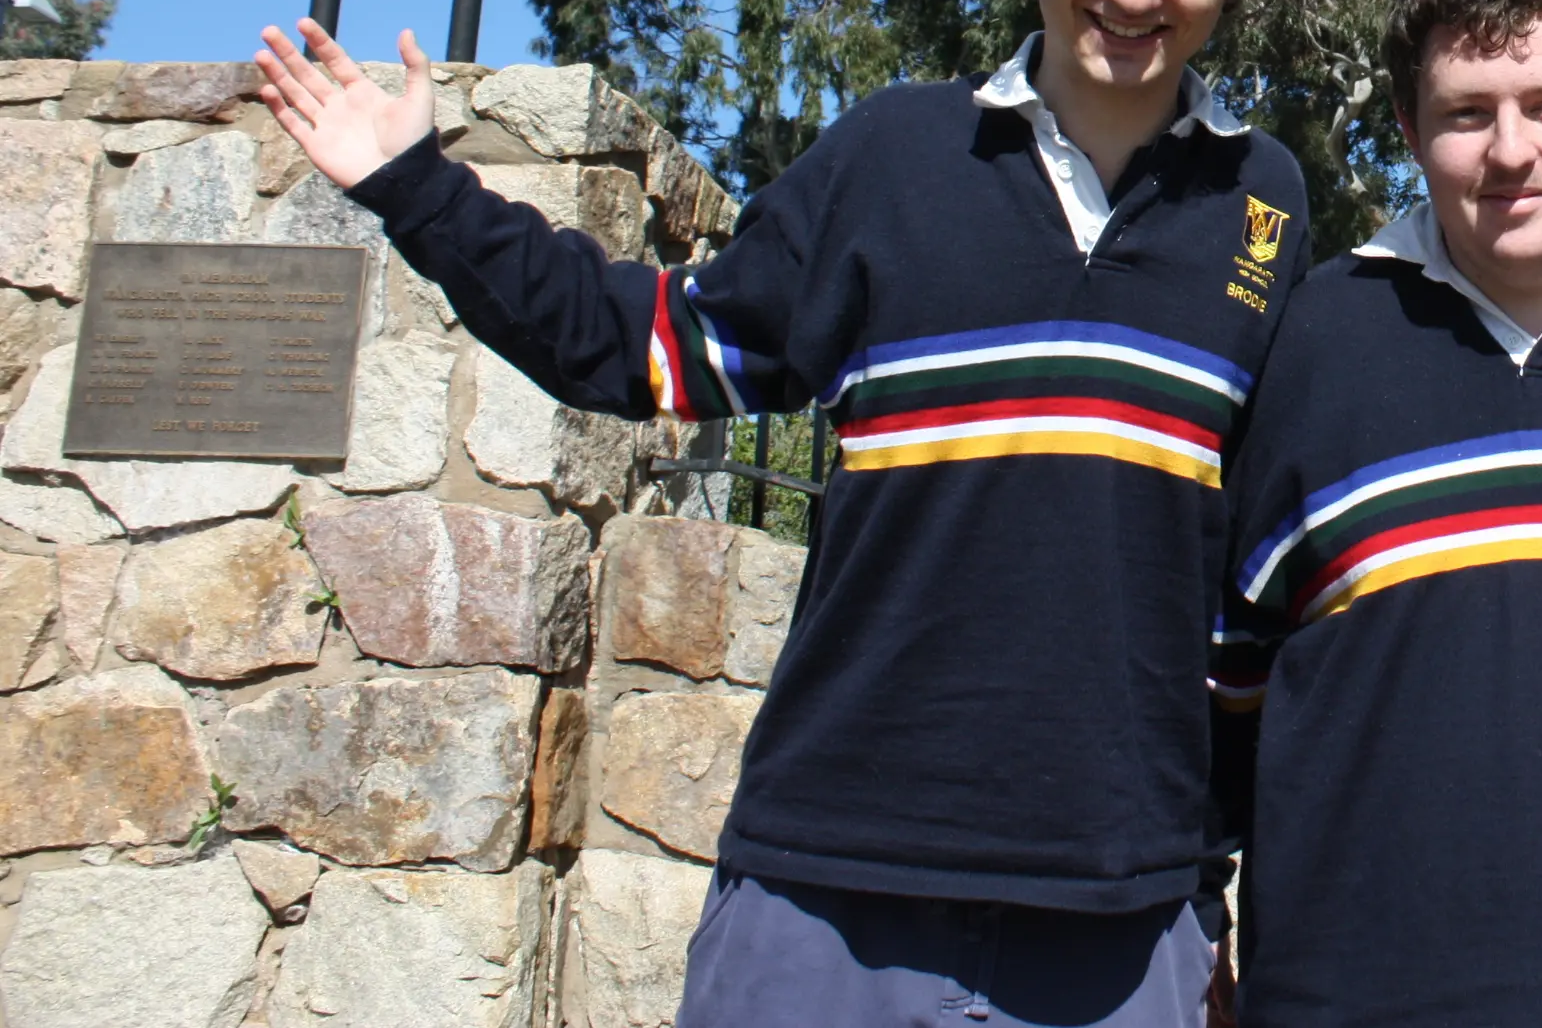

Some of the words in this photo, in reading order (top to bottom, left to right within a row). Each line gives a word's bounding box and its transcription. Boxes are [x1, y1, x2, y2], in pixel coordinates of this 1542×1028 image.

[283, 292, 346, 305] STUDENTS
[1226, 281, 1268, 313] BRODIE
[204, 309, 229, 321] THE
[151, 420, 181, 432] LEST
[186, 420, 206, 433] WE
[212, 420, 261, 433] FORGET
